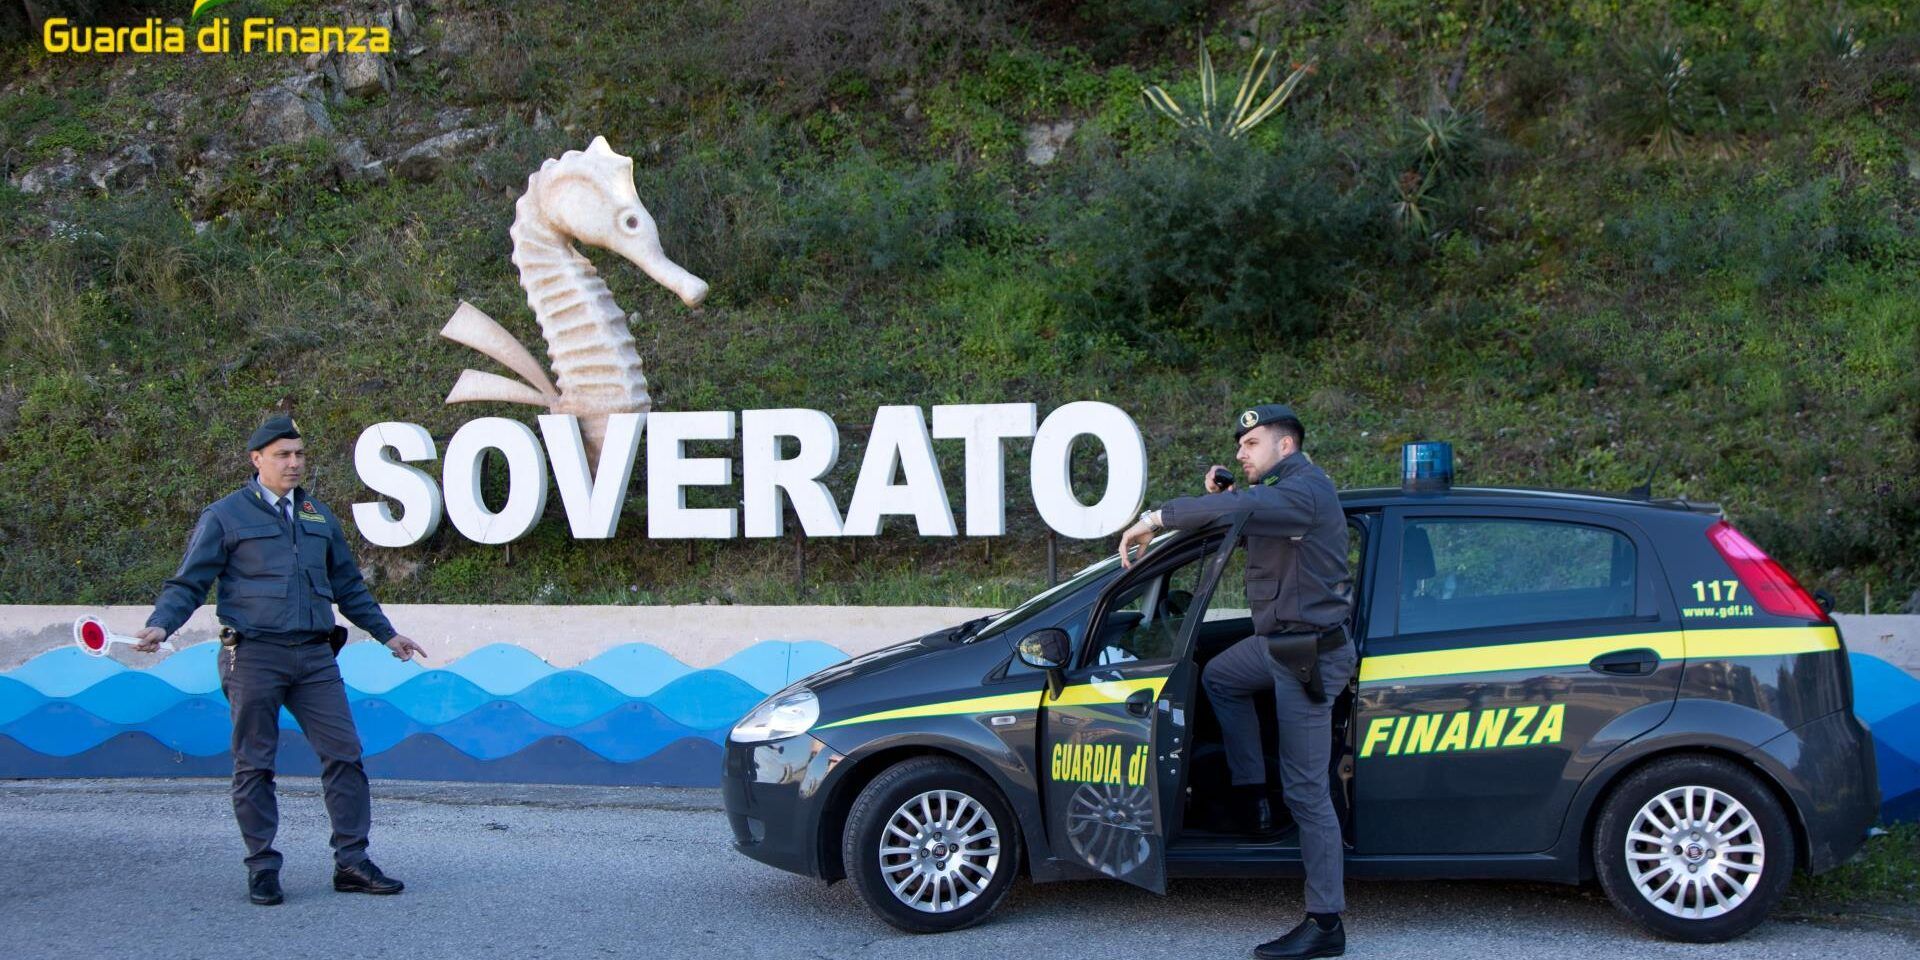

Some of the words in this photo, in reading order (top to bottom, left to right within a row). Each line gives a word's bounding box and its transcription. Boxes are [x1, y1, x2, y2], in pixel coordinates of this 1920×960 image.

[351, 400, 1148, 548] SOVERATO
[1682, 604, 1754, 618] www.gdf.it
[1691, 580, 1739, 602] 117
[1358, 703, 1566, 758] FINANZA
[1051, 743, 1122, 784] GUARDIA
[1128, 744, 1149, 787] di
